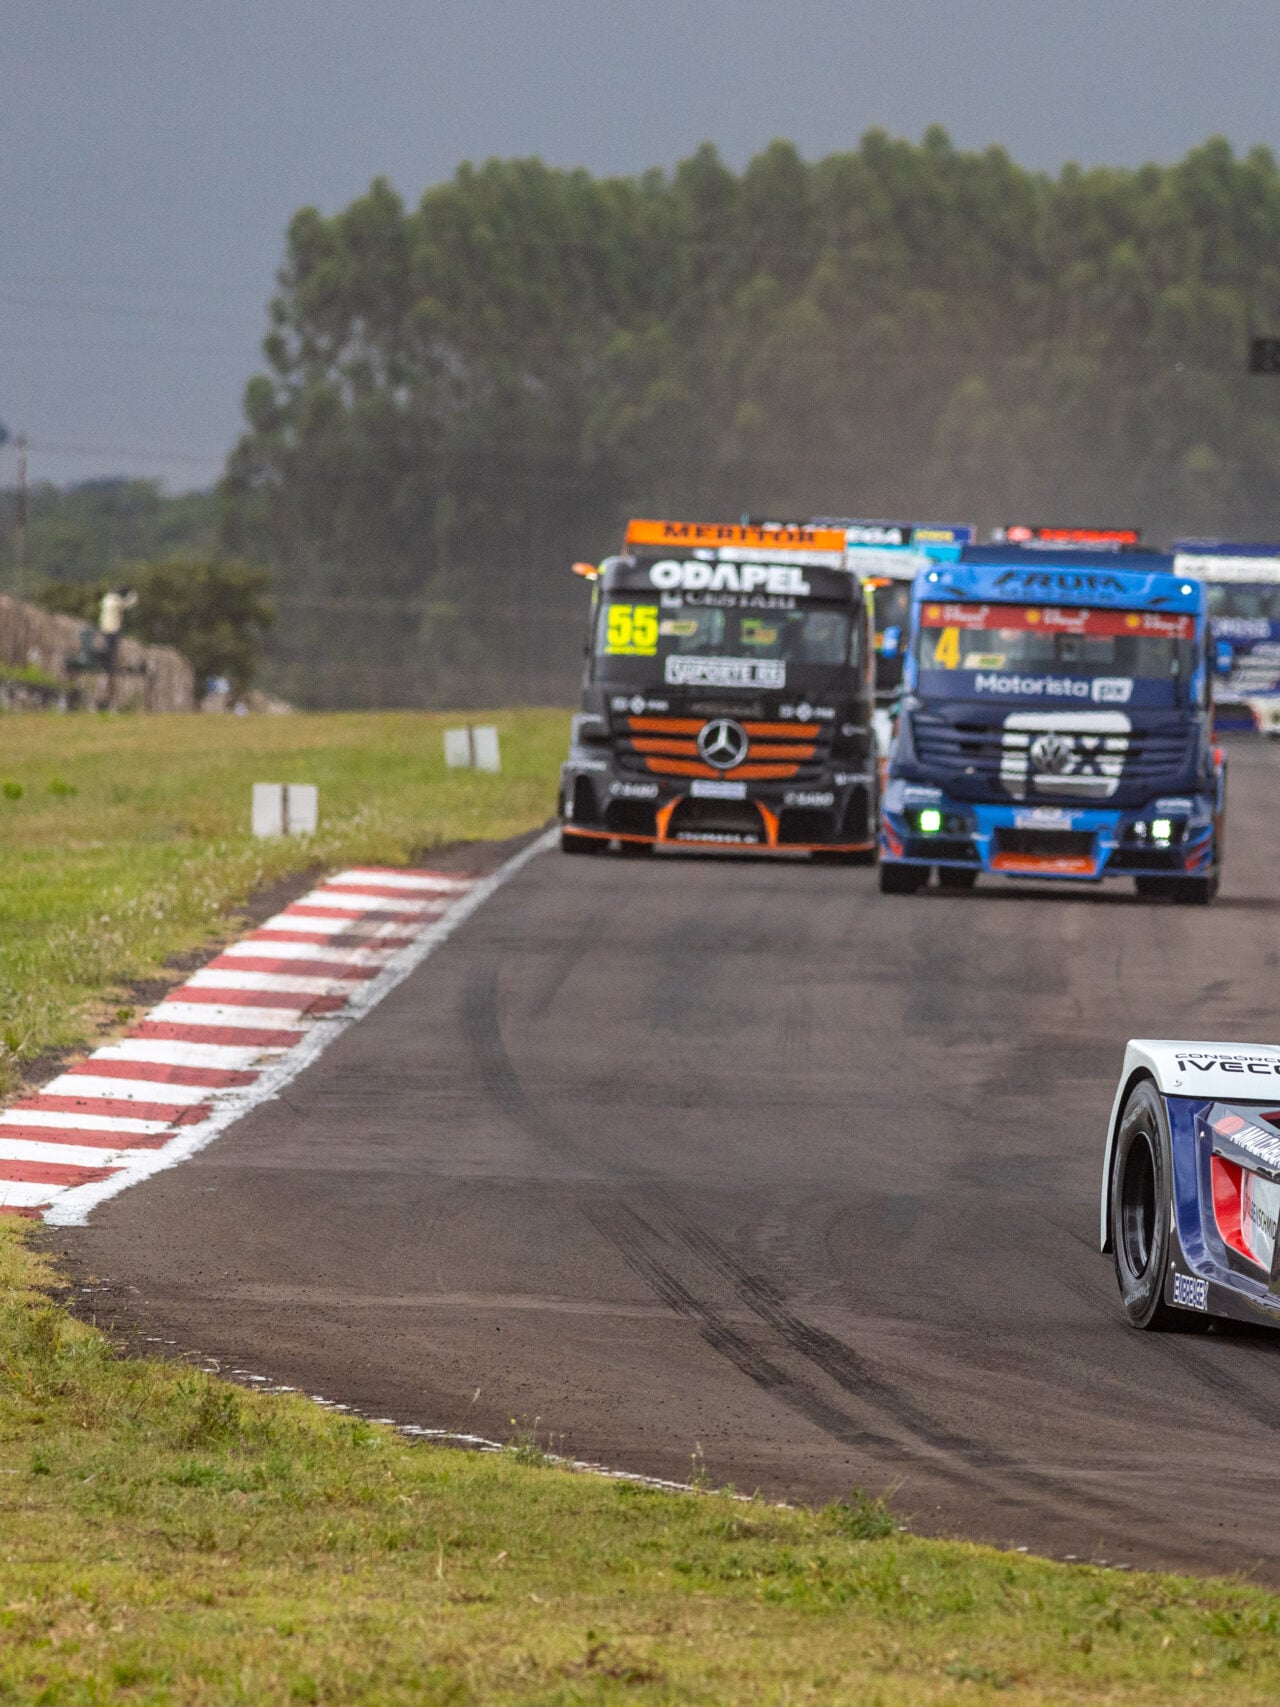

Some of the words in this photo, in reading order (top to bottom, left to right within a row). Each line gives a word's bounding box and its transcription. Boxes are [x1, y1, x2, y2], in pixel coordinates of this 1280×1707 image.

[650, 560, 810, 596] ODAPEL
[607, 604, 659, 648] 55
[934, 626, 961, 670] 4
[975, 673, 1089, 697] Motorista
